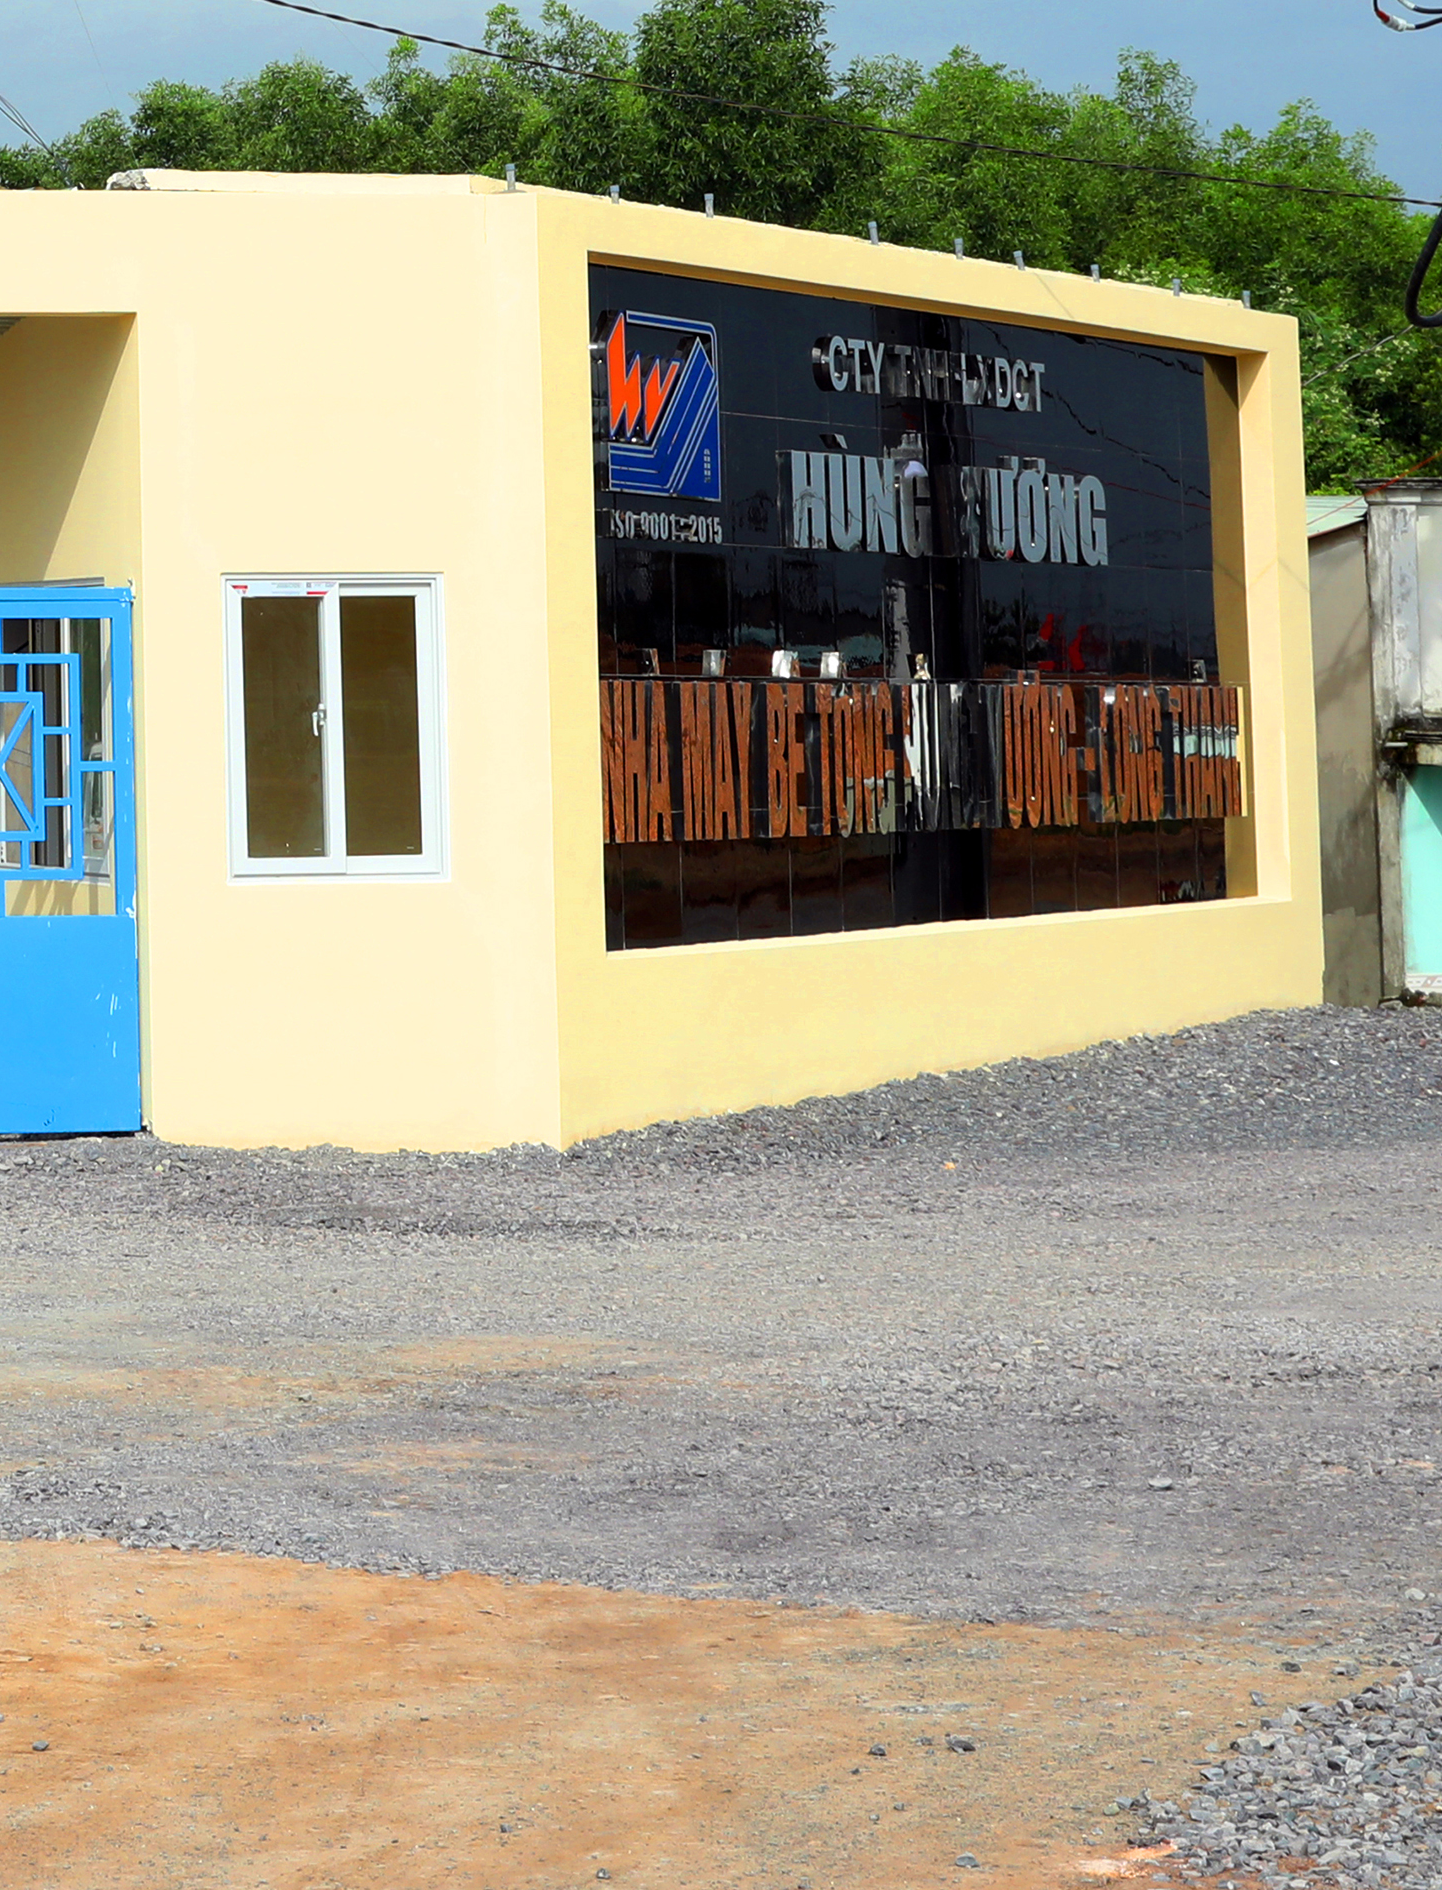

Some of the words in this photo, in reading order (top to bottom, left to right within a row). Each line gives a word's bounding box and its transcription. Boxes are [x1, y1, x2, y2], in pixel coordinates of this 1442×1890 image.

[828, 335, 885, 394] CTY
[789, 434, 932, 558] HÙNG
[688, 514, 722, 544] 2015
